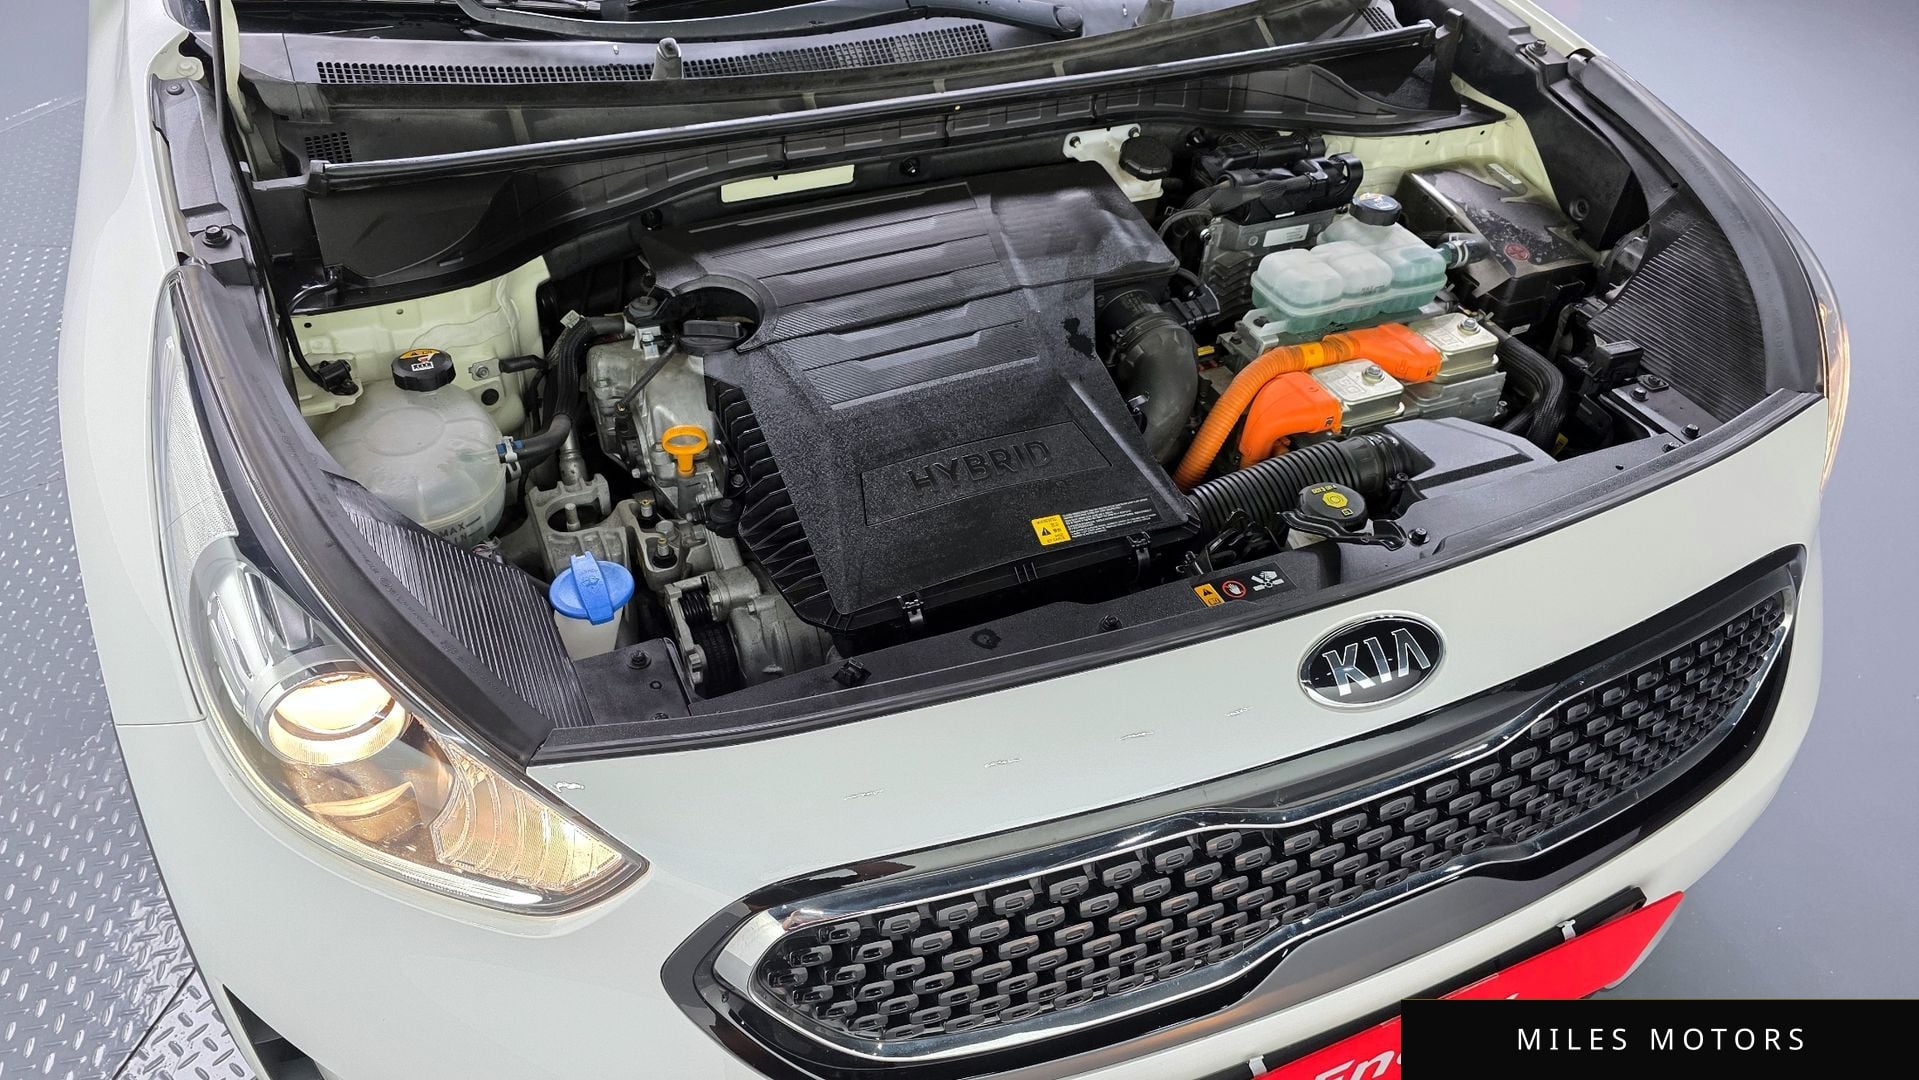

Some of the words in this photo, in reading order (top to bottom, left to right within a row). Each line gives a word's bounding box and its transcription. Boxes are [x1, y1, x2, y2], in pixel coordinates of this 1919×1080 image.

[906, 440, 1050, 495] HYBRID
[439, 522, 466, 537] MAX
[1322, 628, 1431, 696] KIA
